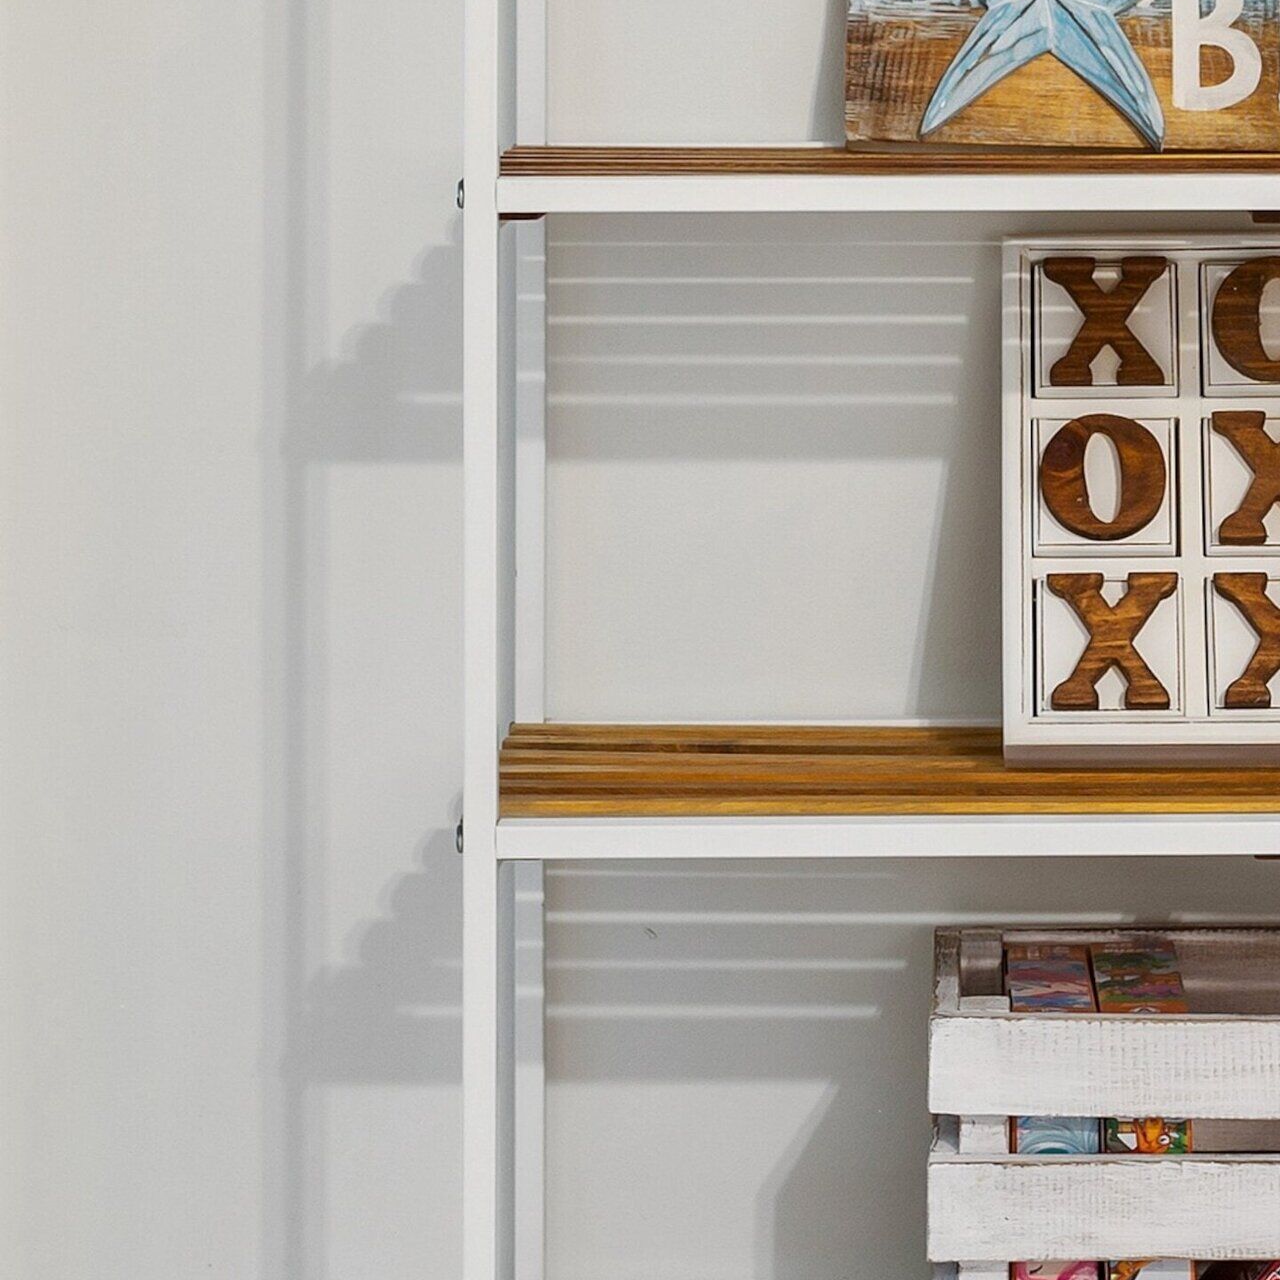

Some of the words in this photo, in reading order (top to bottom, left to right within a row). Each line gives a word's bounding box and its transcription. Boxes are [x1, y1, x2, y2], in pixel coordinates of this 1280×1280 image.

[1043, 256, 1166, 387] X
[1042, 413, 1166, 541] O
[1047, 572, 1178, 711] X
